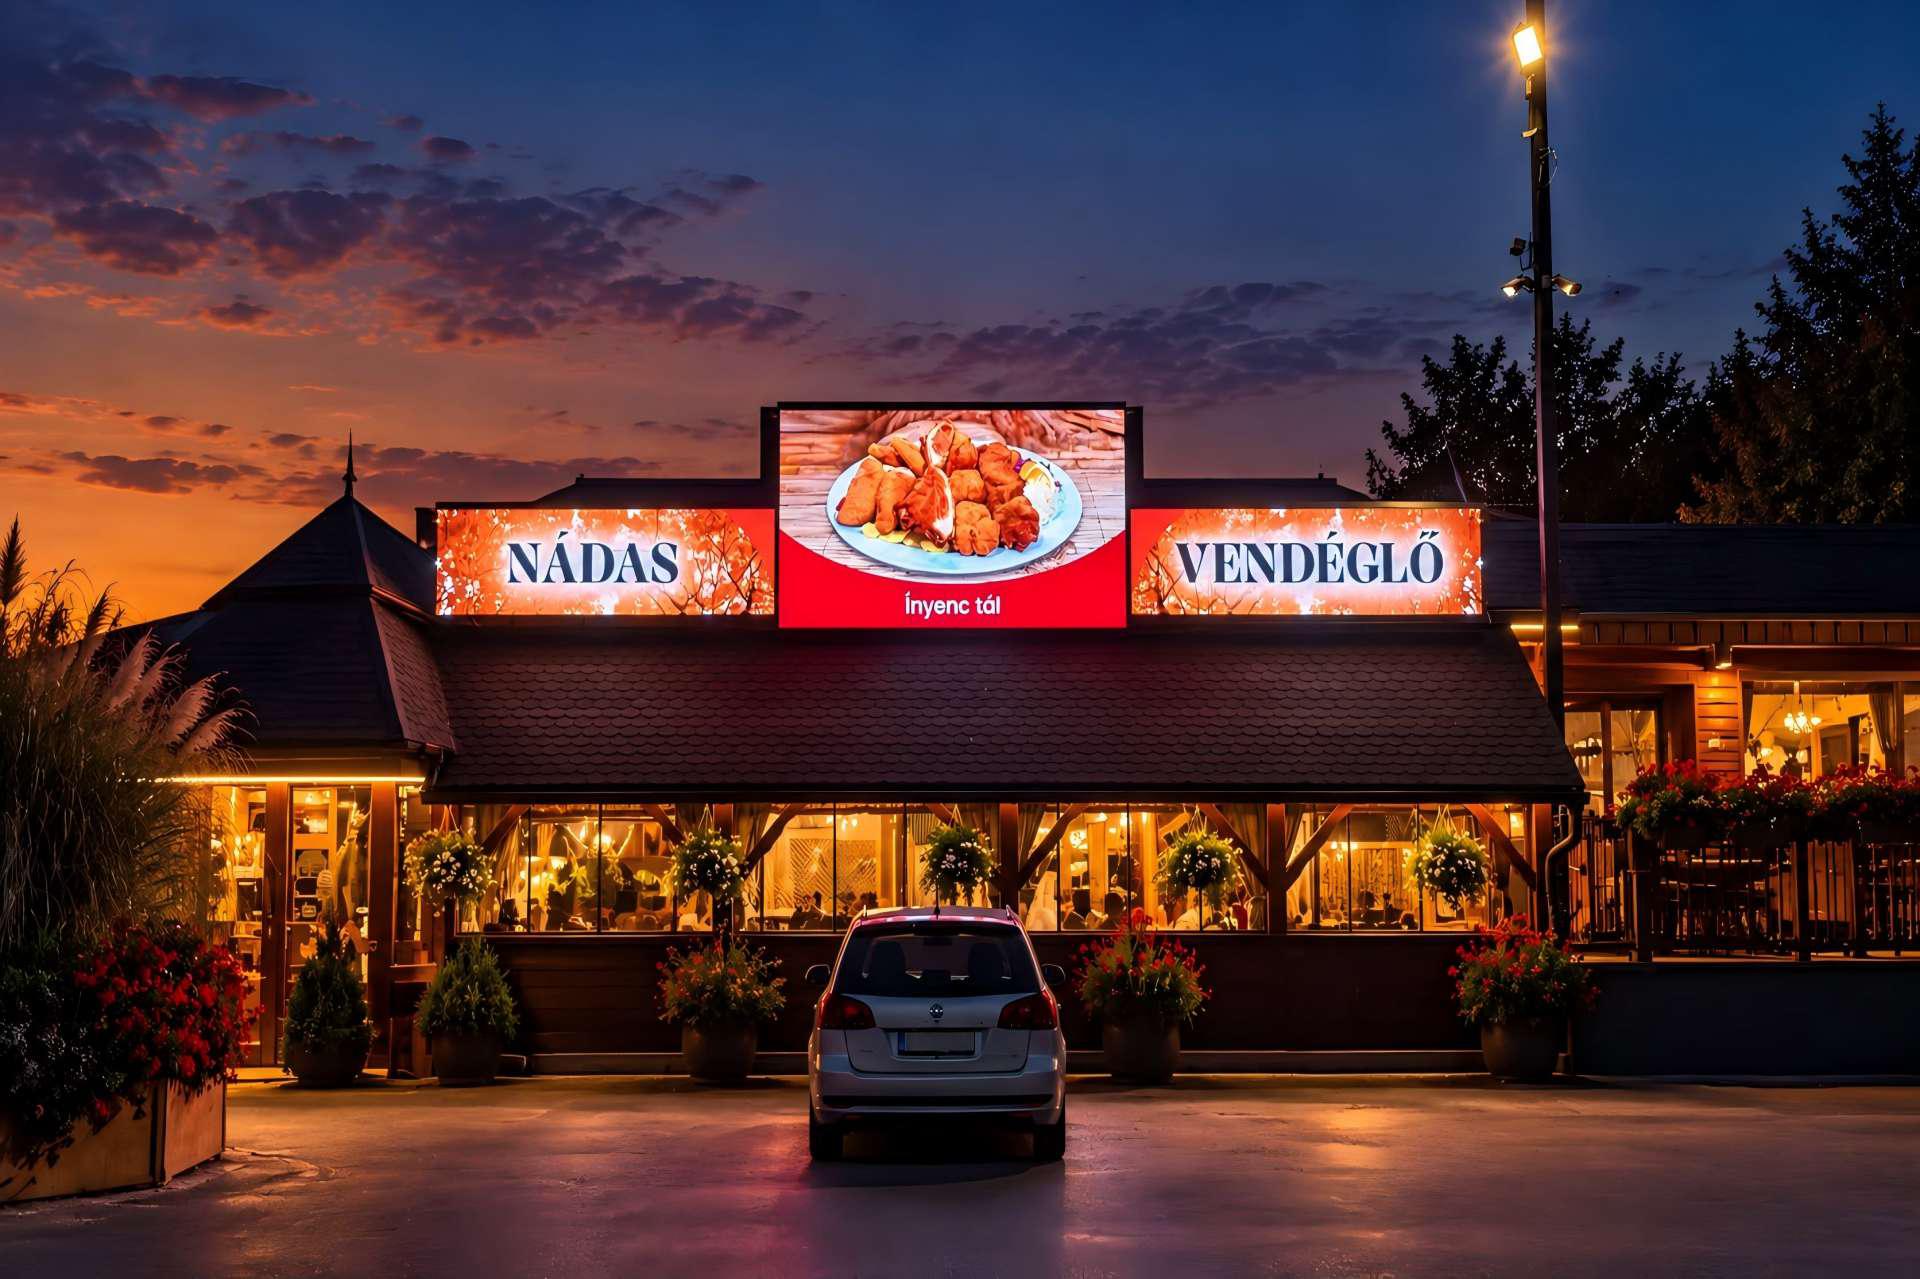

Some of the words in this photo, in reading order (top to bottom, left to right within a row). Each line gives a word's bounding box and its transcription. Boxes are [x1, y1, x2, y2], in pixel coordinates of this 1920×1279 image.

[507, 530, 679, 584] NÁDAS
[1175, 530, 1444, 584] VENDÉGLŐ
[904, 590, 970, 620] Ínyenc
[974, 593, 1001, 615] tál
